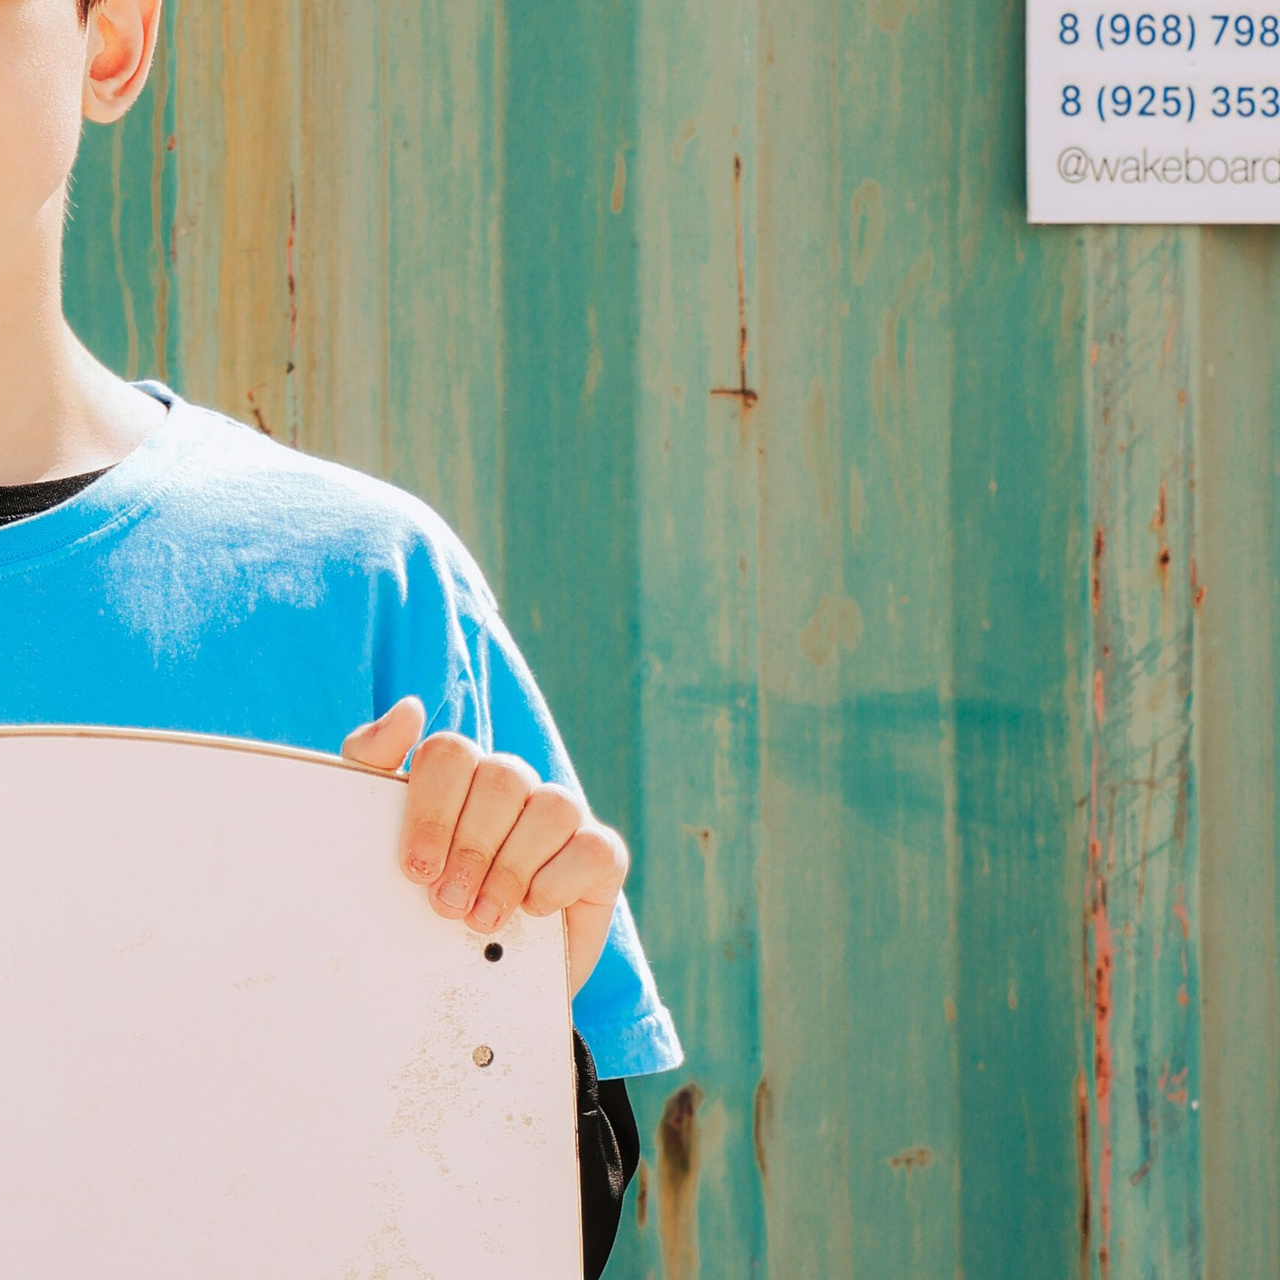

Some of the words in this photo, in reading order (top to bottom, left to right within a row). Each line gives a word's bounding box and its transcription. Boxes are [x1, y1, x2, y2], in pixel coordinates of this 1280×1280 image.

[1058, 11, 1081, 47] 8
[1095, 12, 1197, 52] (968)
[1210, 14, 1280, 48] 798
[1060, 84, 1083, 118] 8
[1096, 84, 1196, 123] (925)
[1210, 84, 1280, 119] 353
[1056, 145, 1280, 184] @wakeboard
